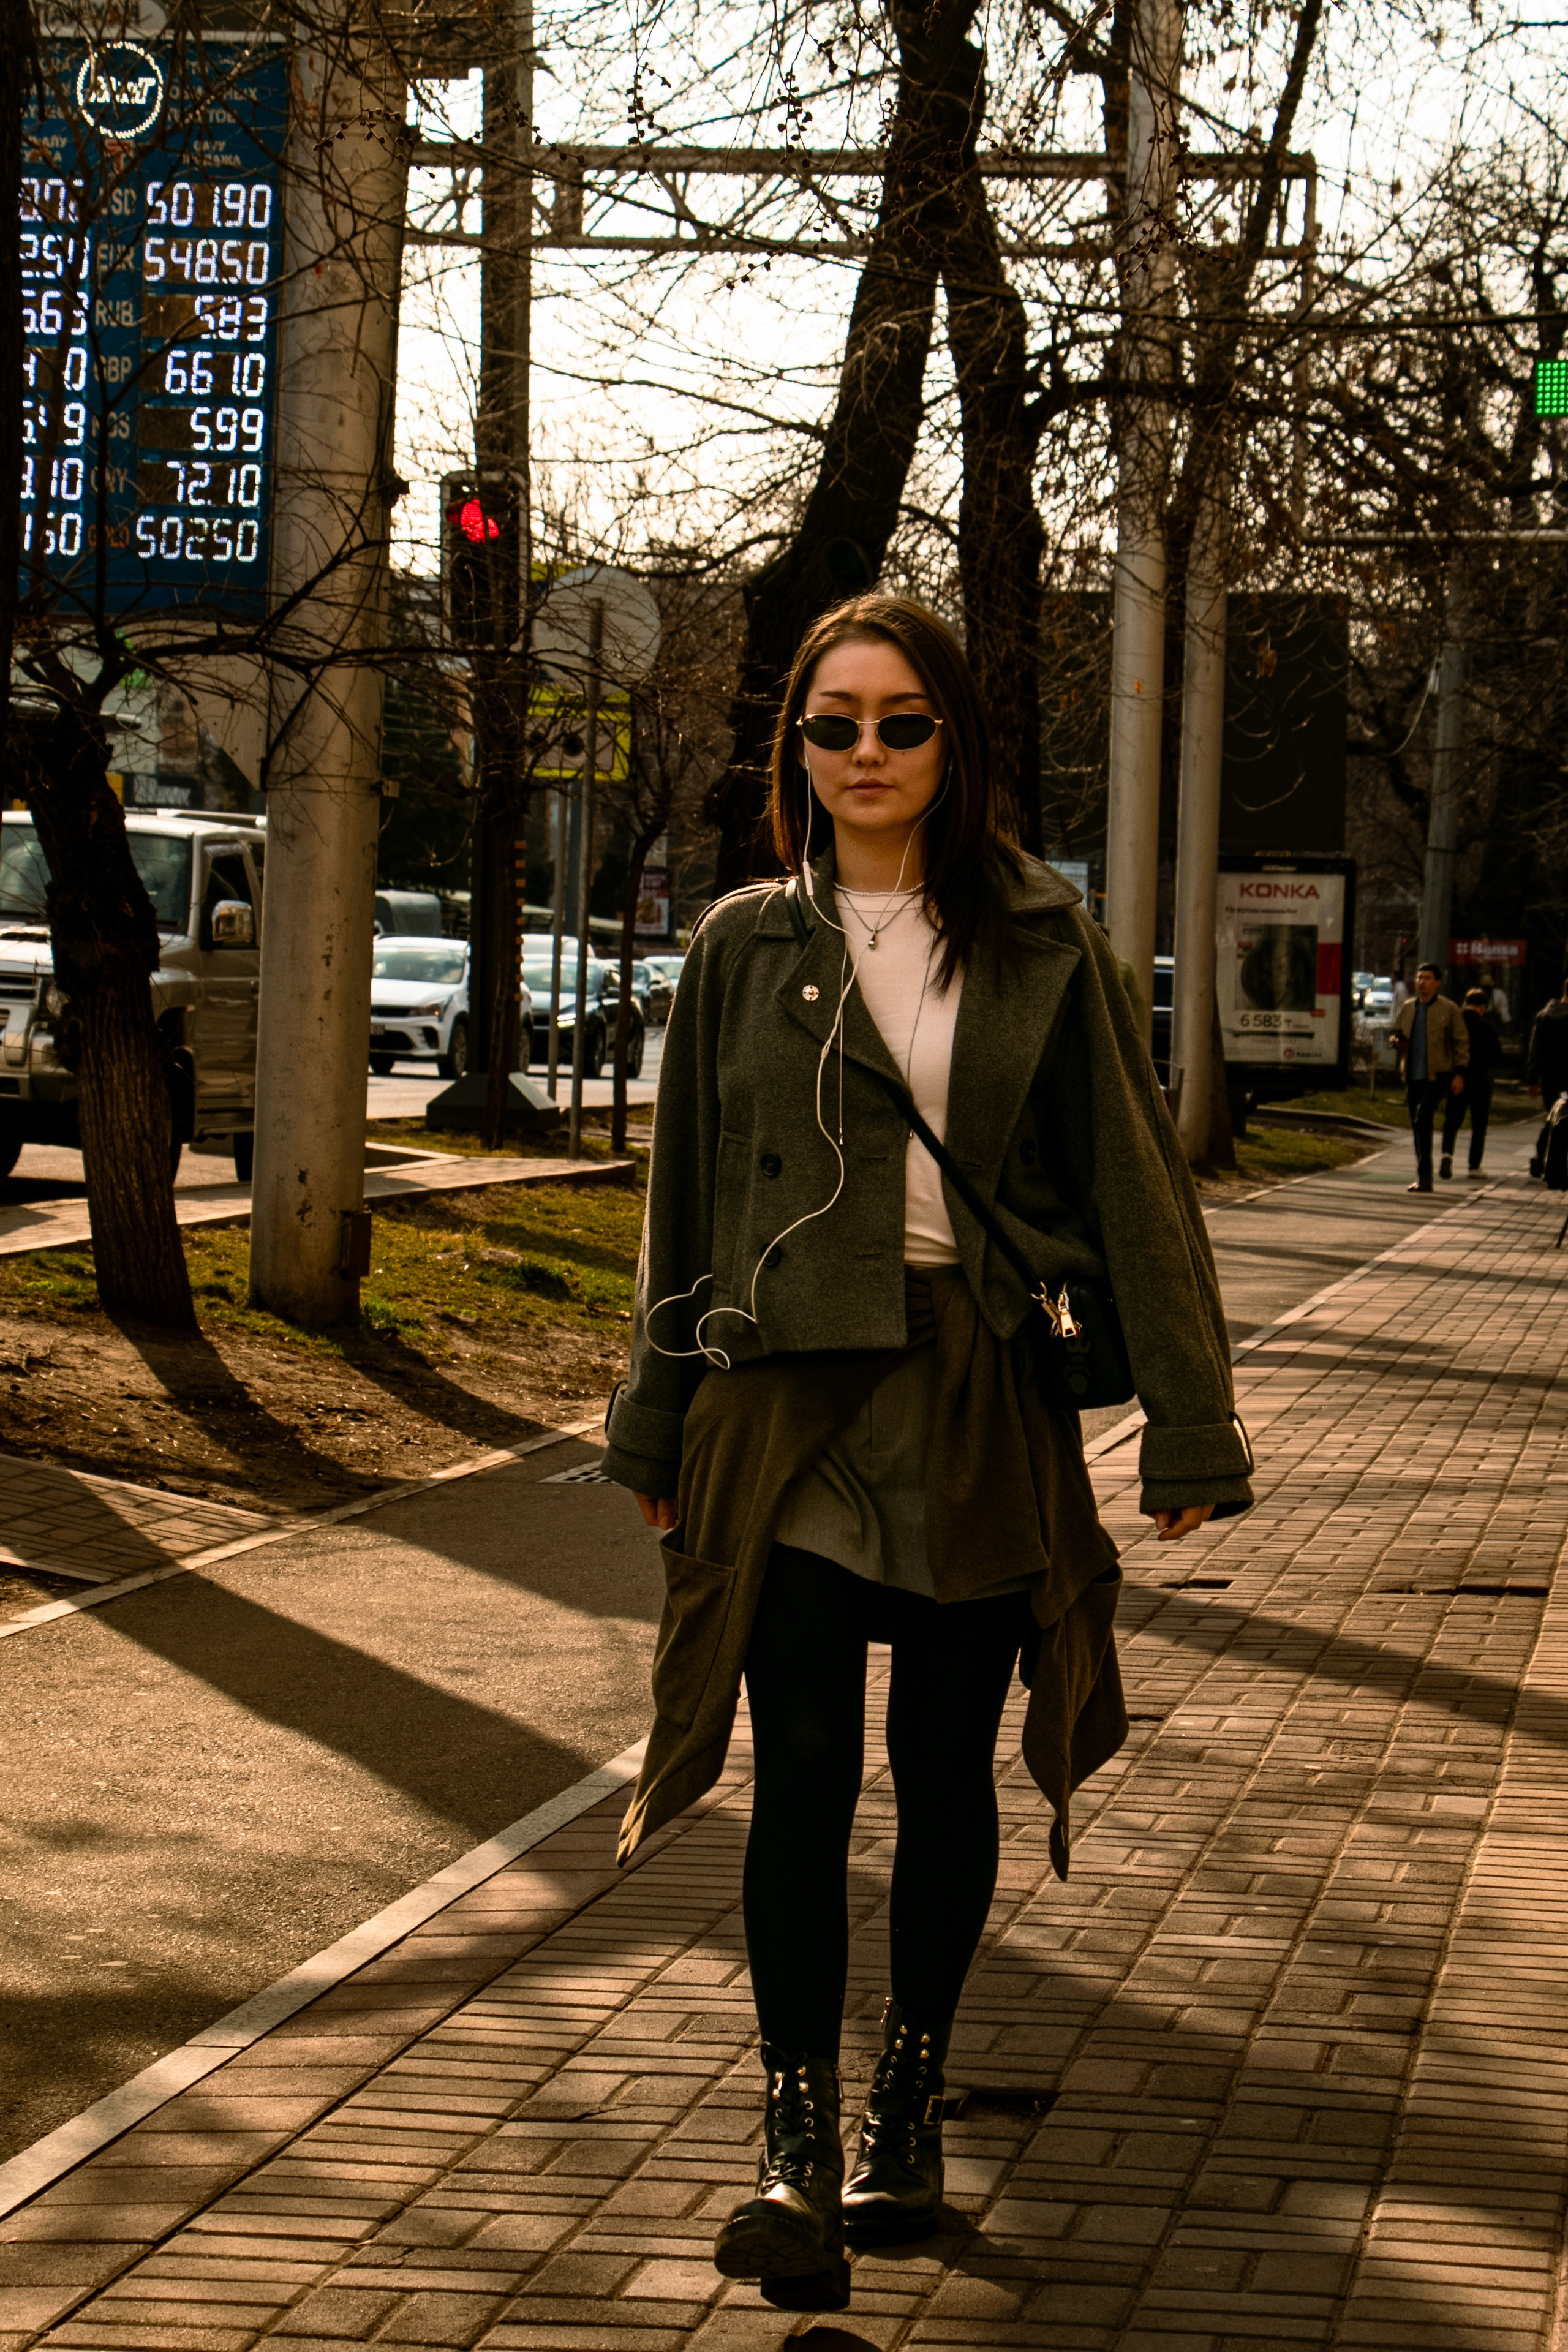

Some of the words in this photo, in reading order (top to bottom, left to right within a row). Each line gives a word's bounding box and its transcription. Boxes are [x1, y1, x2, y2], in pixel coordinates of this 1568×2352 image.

[97, 243, 135, 272] EUR
[94, 300, 134, 328] RUB
[93, 355, 132, 383] GBP
[136, 515, 260, 562] 50250
[1240, 883, 1320, 899] KONKA
